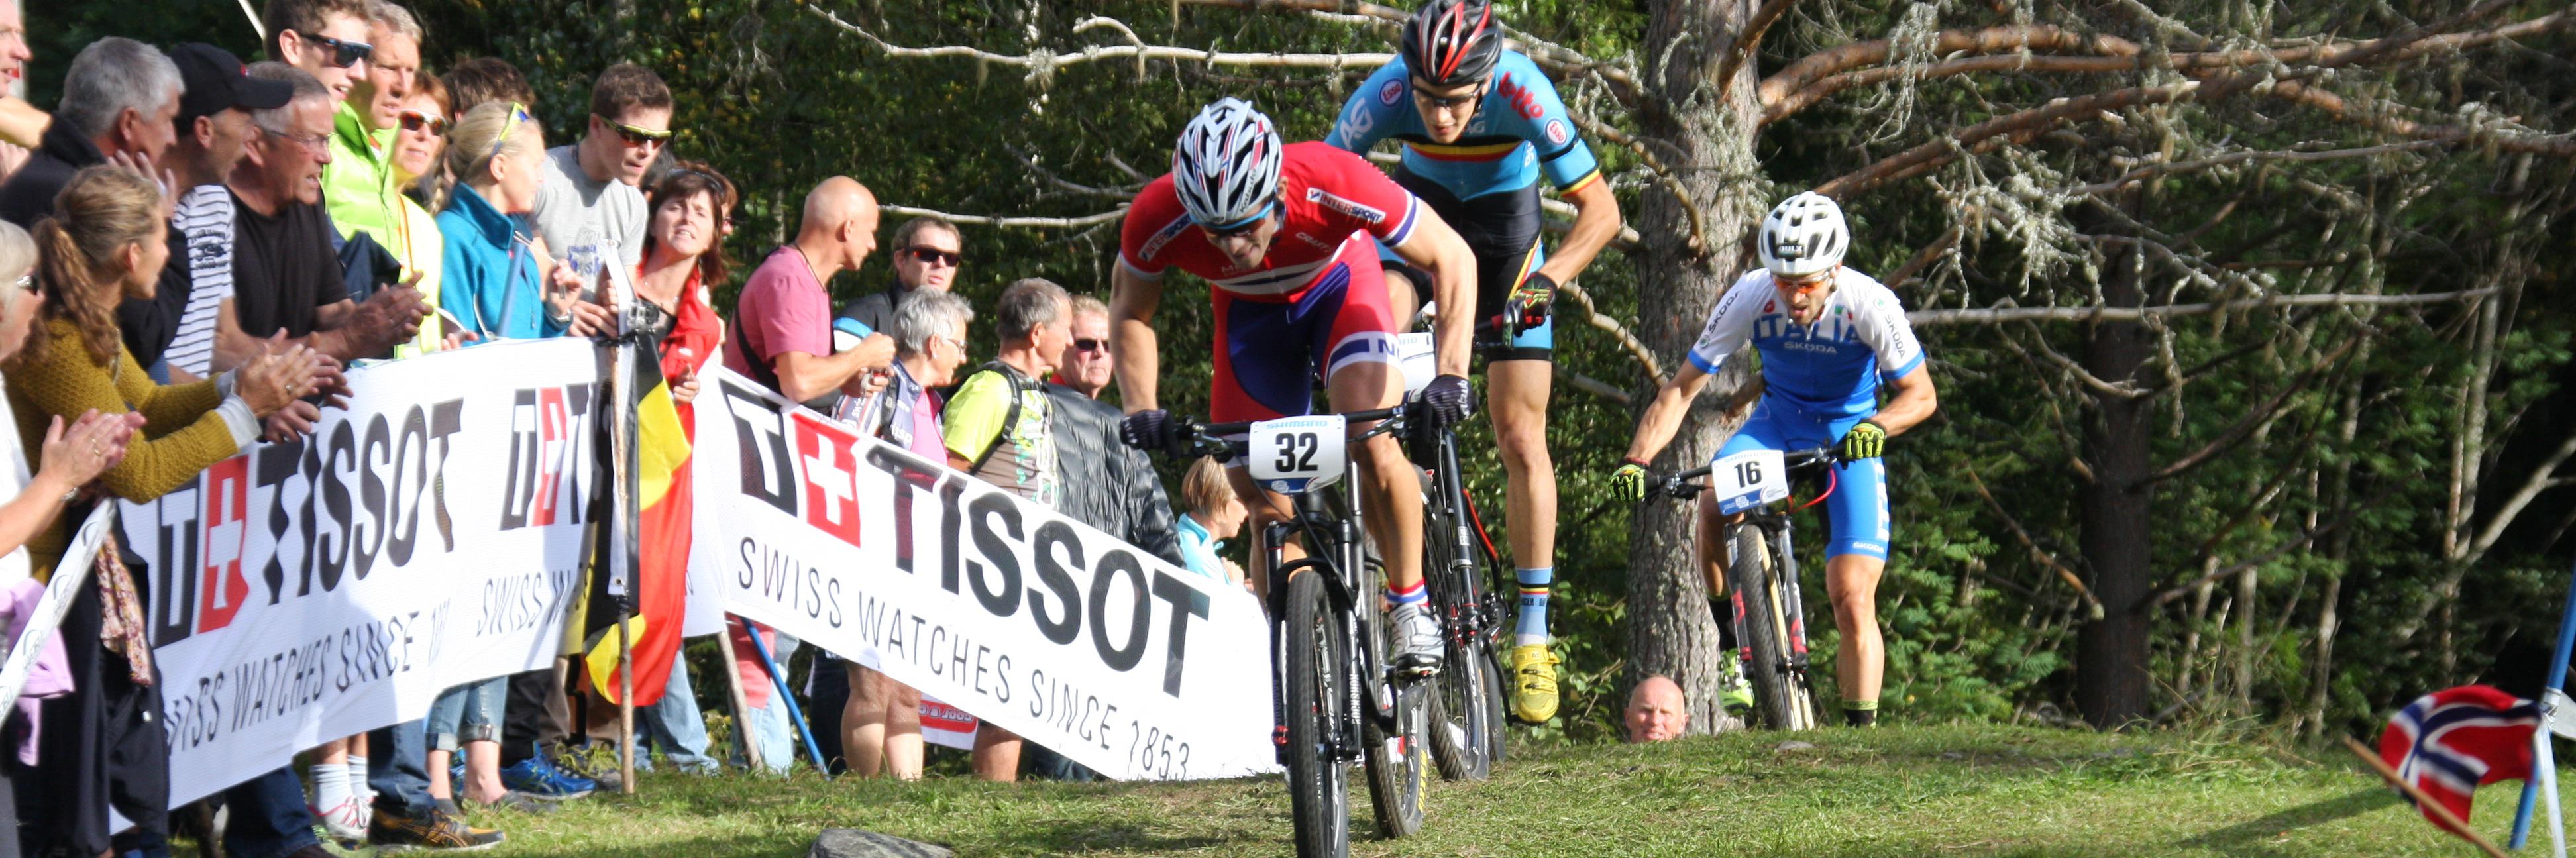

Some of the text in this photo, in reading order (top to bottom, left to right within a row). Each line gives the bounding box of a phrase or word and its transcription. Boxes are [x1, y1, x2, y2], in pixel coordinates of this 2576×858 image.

[1320, 192, 1382, 223] INTERSPORT
[1275, 432, 1318, 472] 32
[1734, 460, 1762, 488] 16
[256, 396, 464, 606] TISSOT
[476, 571, 543, 637] SWISS
[865, 444, 1211, 699] TISSOT
[231, 634, 331, 733] WATCHES
[737, 537, 1190, 780] SWISS WATCHES SINCE 1853
